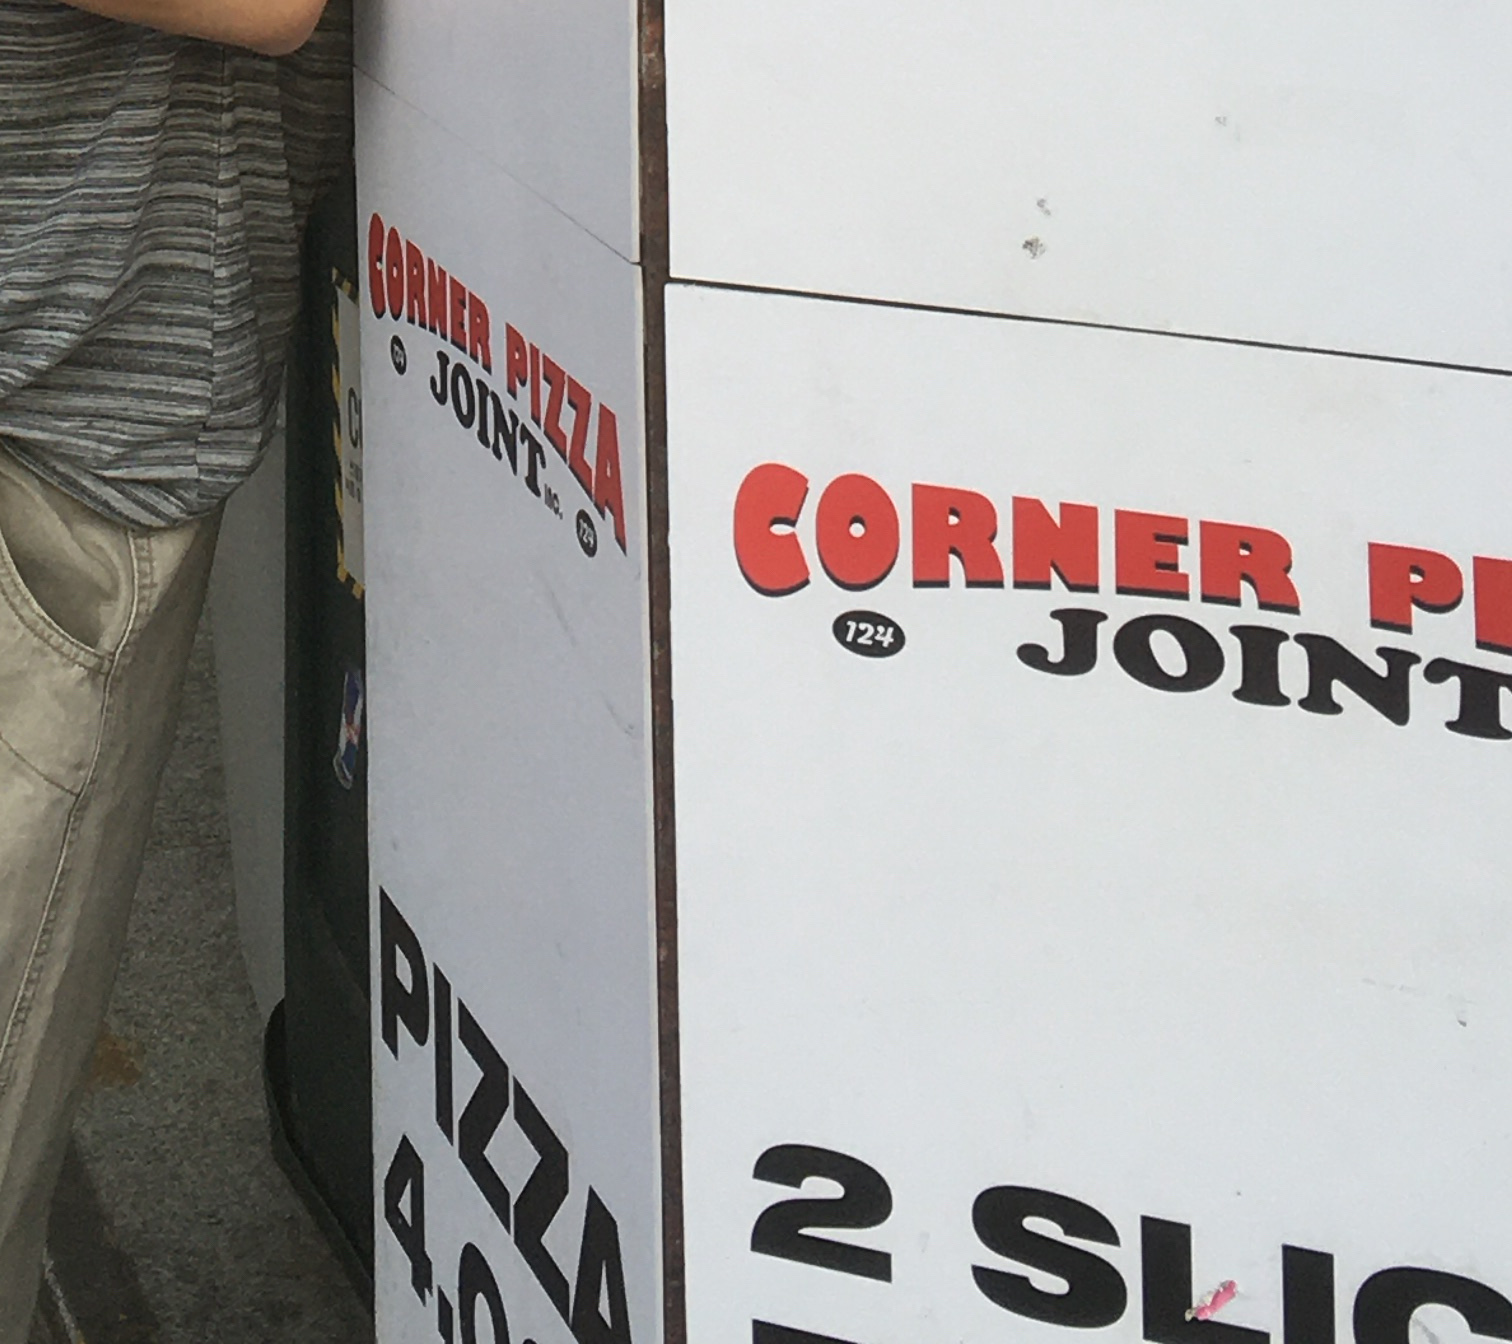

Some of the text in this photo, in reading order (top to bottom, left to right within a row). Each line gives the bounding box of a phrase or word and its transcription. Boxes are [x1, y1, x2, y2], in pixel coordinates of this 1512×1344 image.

[367, 213, 628, 557] CORNER PIZZA
[430, 350, 547, 499] JOINT
[732, 462, 1301, 615] CORNER
[843, 618, 897, 651] 124
[1016, 607, 1512, 742] JOINT
[379, 885, 633, 1344] PIZZA
[749, 1143, 895, 1284] 2
